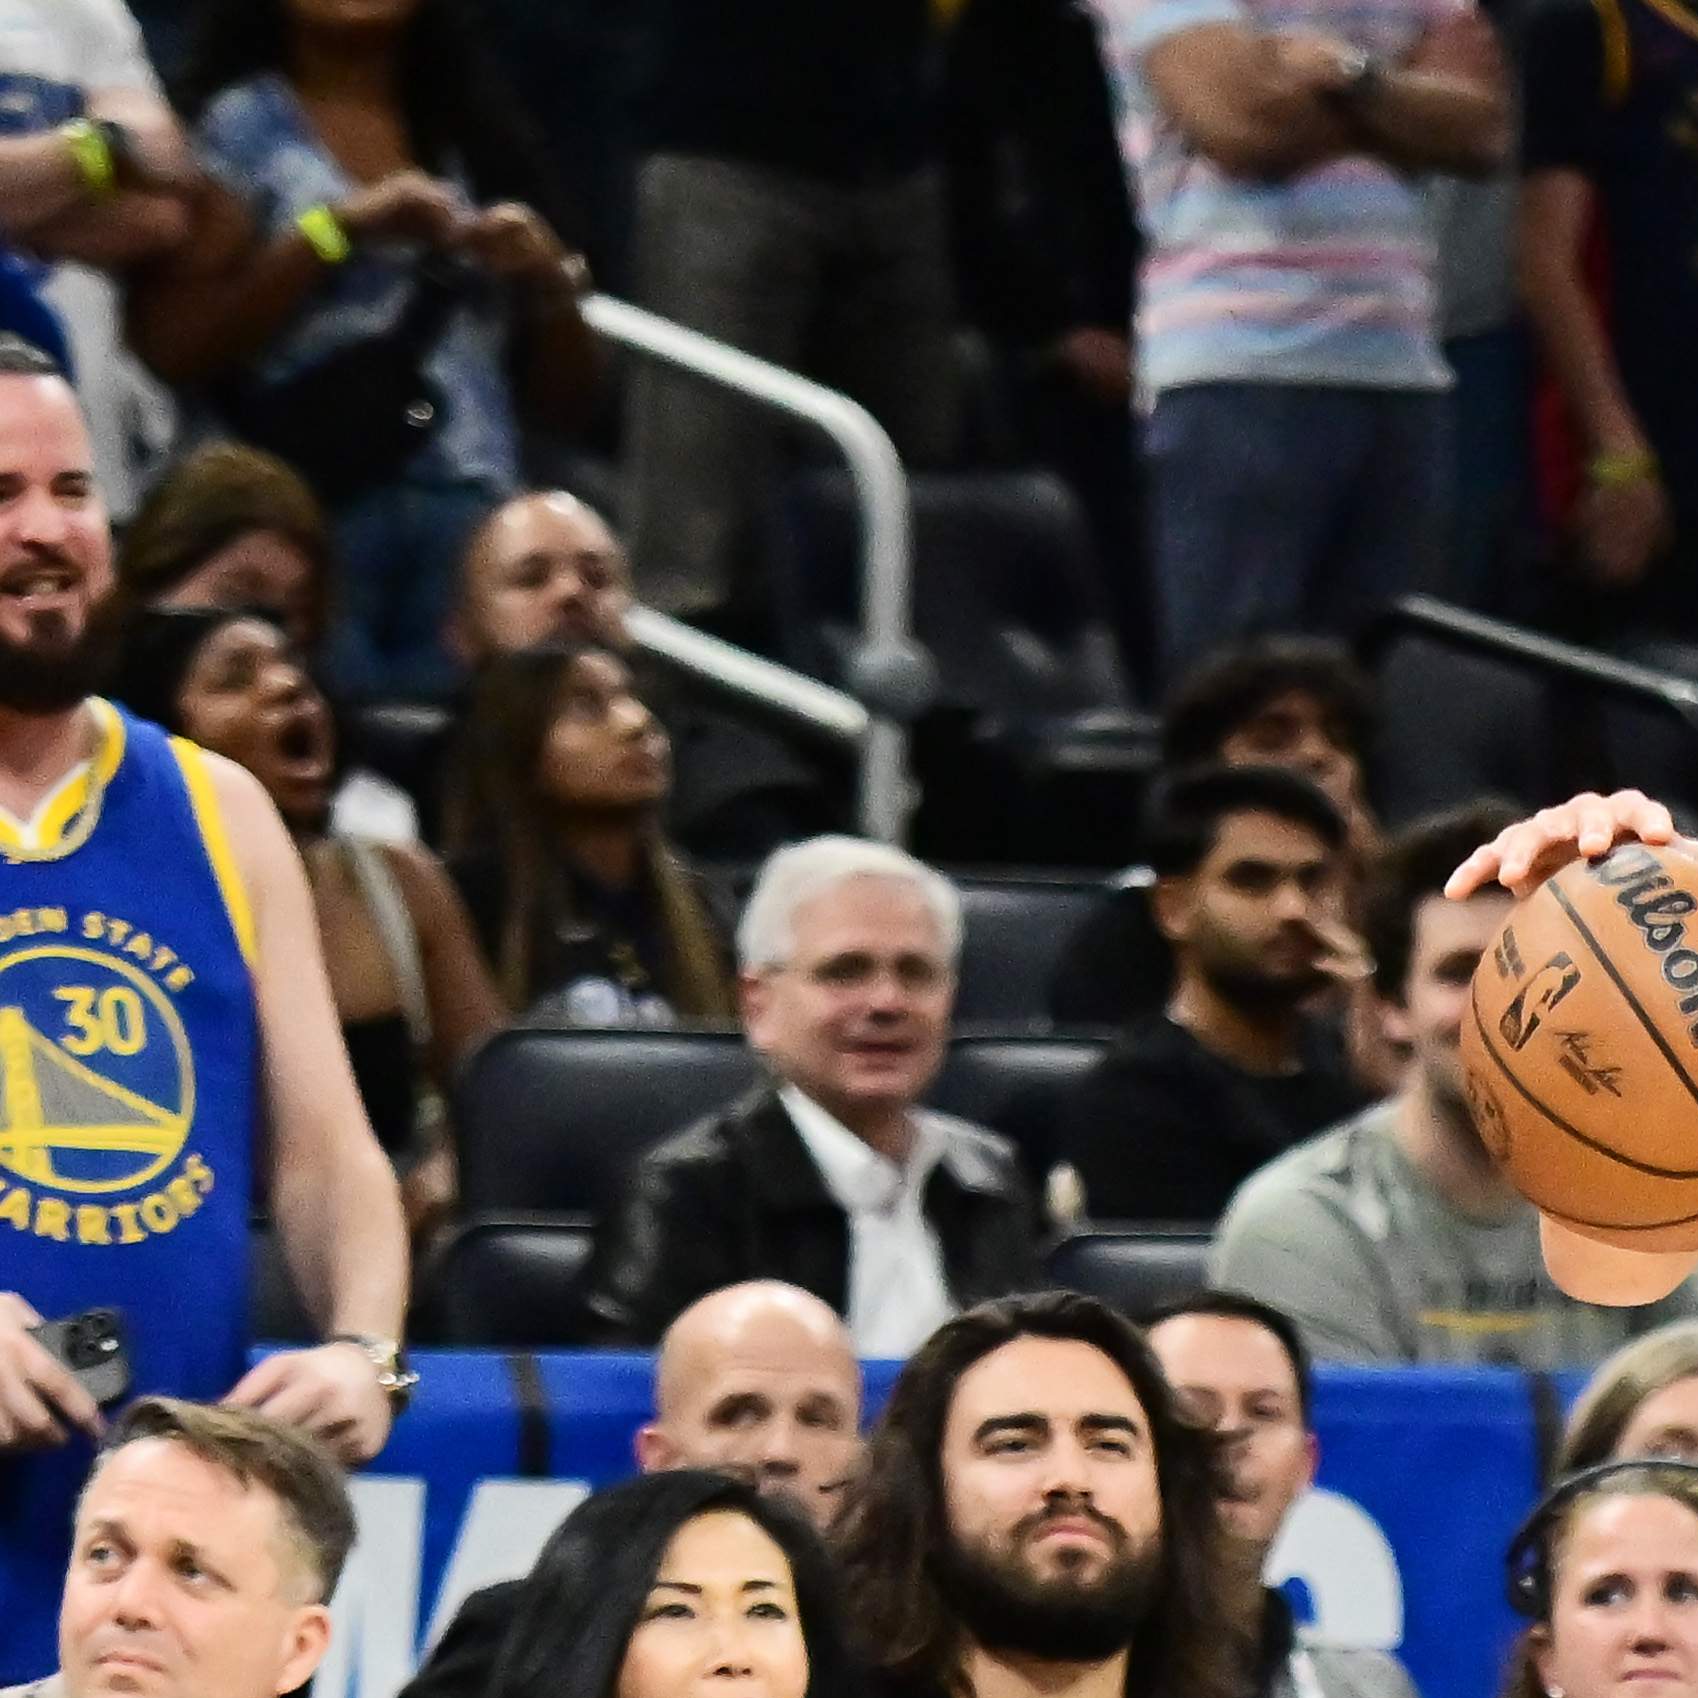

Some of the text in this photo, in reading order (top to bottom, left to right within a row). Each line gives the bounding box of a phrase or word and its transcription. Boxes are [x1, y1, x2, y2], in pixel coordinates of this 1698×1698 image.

[0, 905, 195, 992] DEN STATE
[52, 985, 146, 1056] 30
[0, 1152, 215, 1245] ARRIORS
